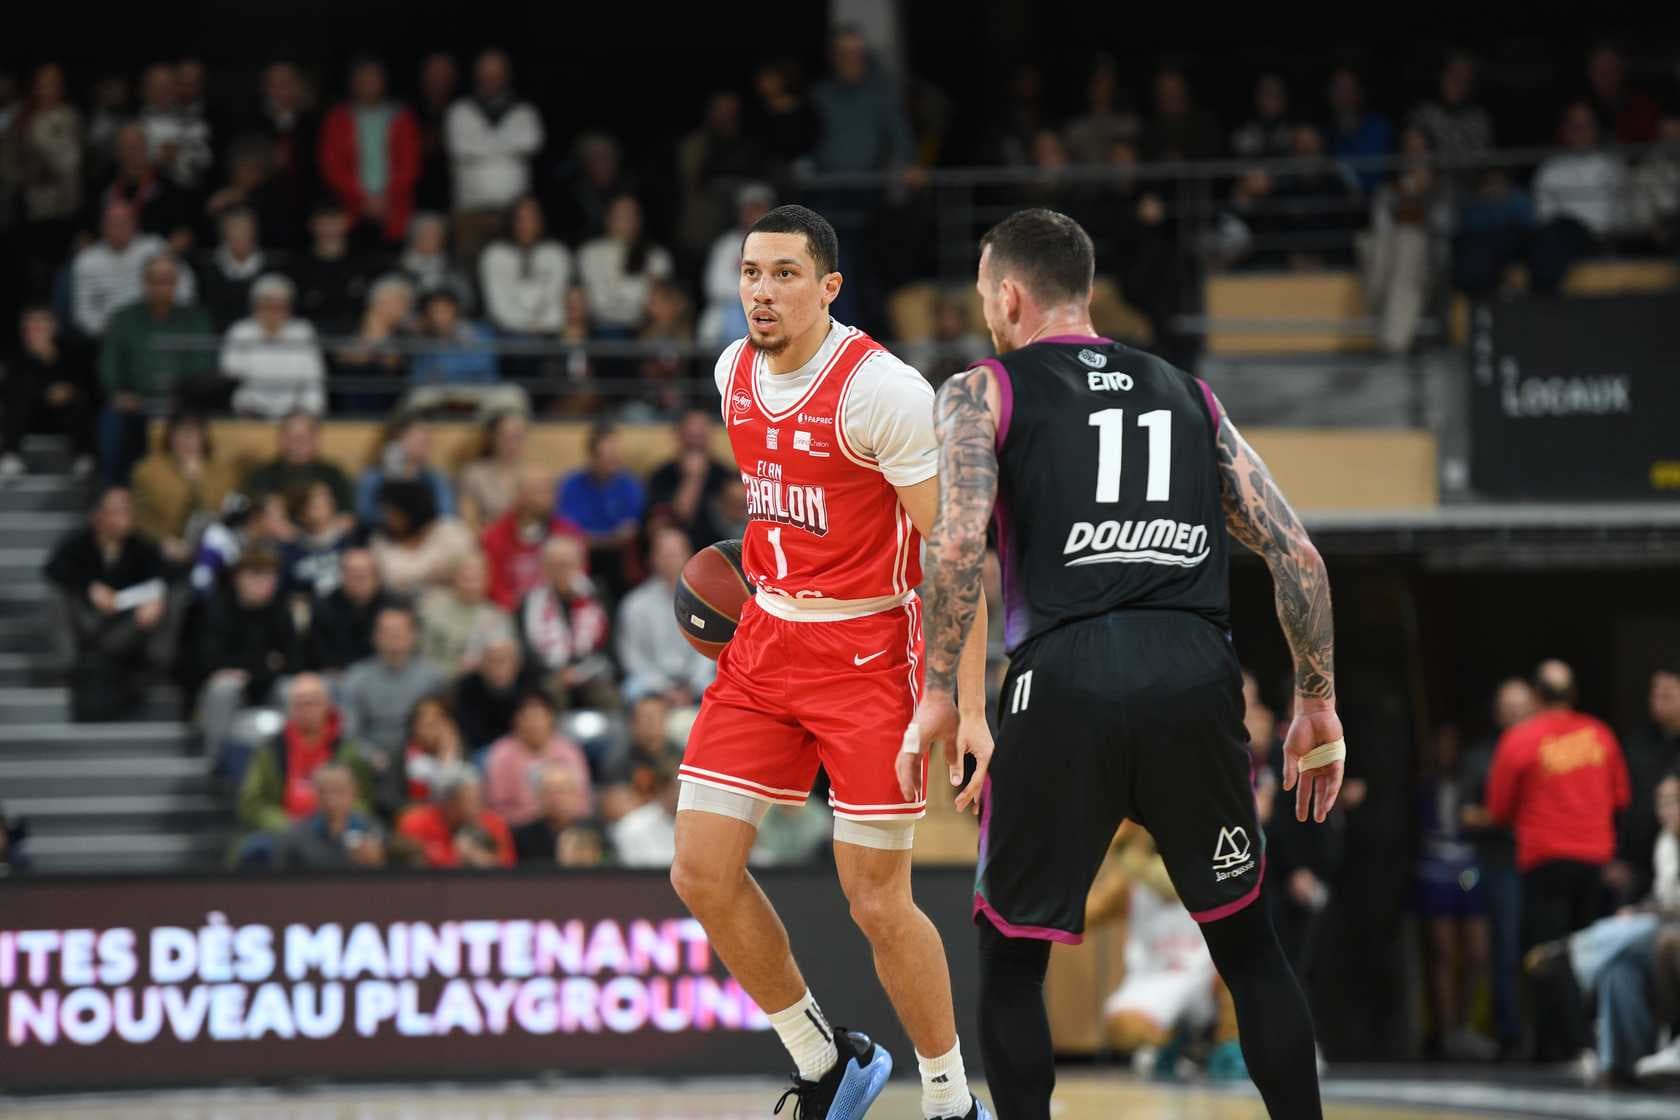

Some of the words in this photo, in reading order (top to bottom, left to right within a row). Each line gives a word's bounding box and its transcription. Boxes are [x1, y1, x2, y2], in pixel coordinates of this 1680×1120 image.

[1088, 408, 1172, 503] 11
[767, 526, 788, 580] 1
[1063, 518, 1208, 555] DOUMEN
[1011, 669, 1033, 715] 11
[150, 909, 276, 984] DÈS
[284, 918, 709, 982] MAINTENANT
[7, 981, 345, 1046] NOUVEAU
